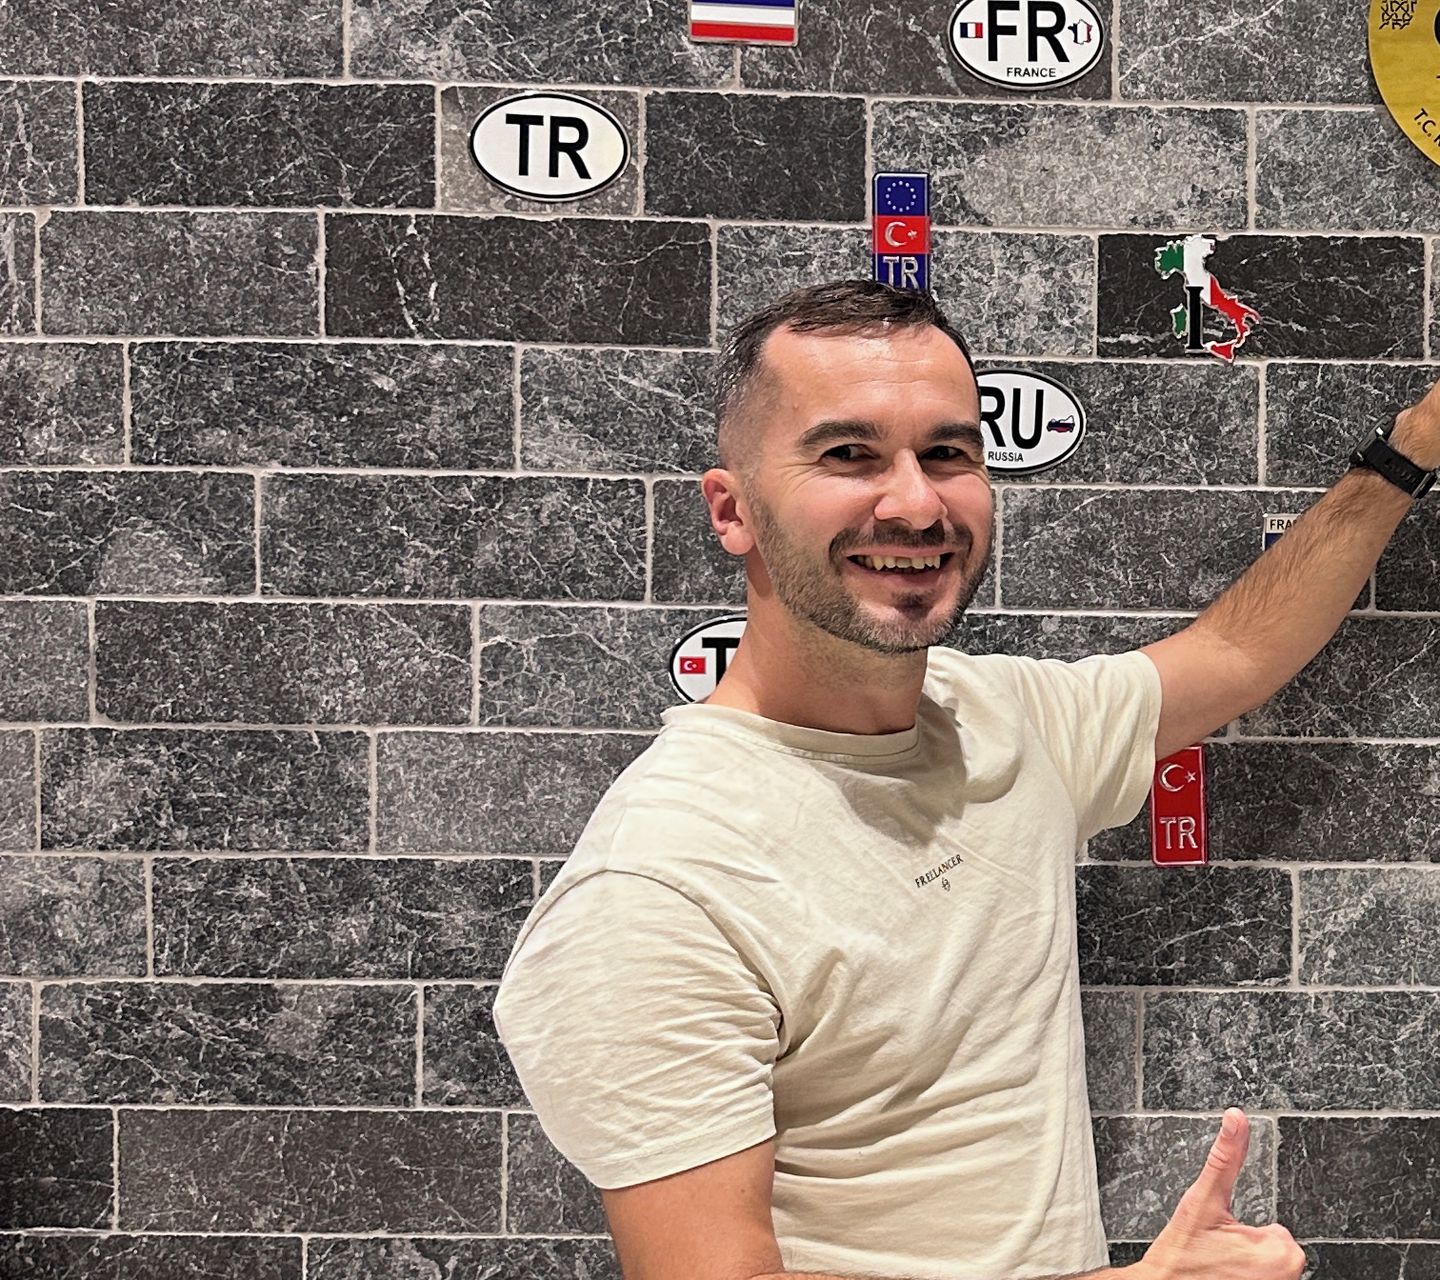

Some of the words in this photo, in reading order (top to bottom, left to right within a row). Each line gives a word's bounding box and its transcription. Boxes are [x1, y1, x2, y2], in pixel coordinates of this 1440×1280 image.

[986, 0, 1070, 63] FR
[1006, 67, 1057, 78] FRANCE
[1413, 107, 1437, 137] T.C.
[505, 113, 592, 180] TR
[882, 255, 920, 289] TR
[978, 385, 1044, 450] RU
[987, 450, 1024, 462] RUSSIA
[1270, 519, 1297, 530] FRA
[1159, 815, 1199, 850] TR
